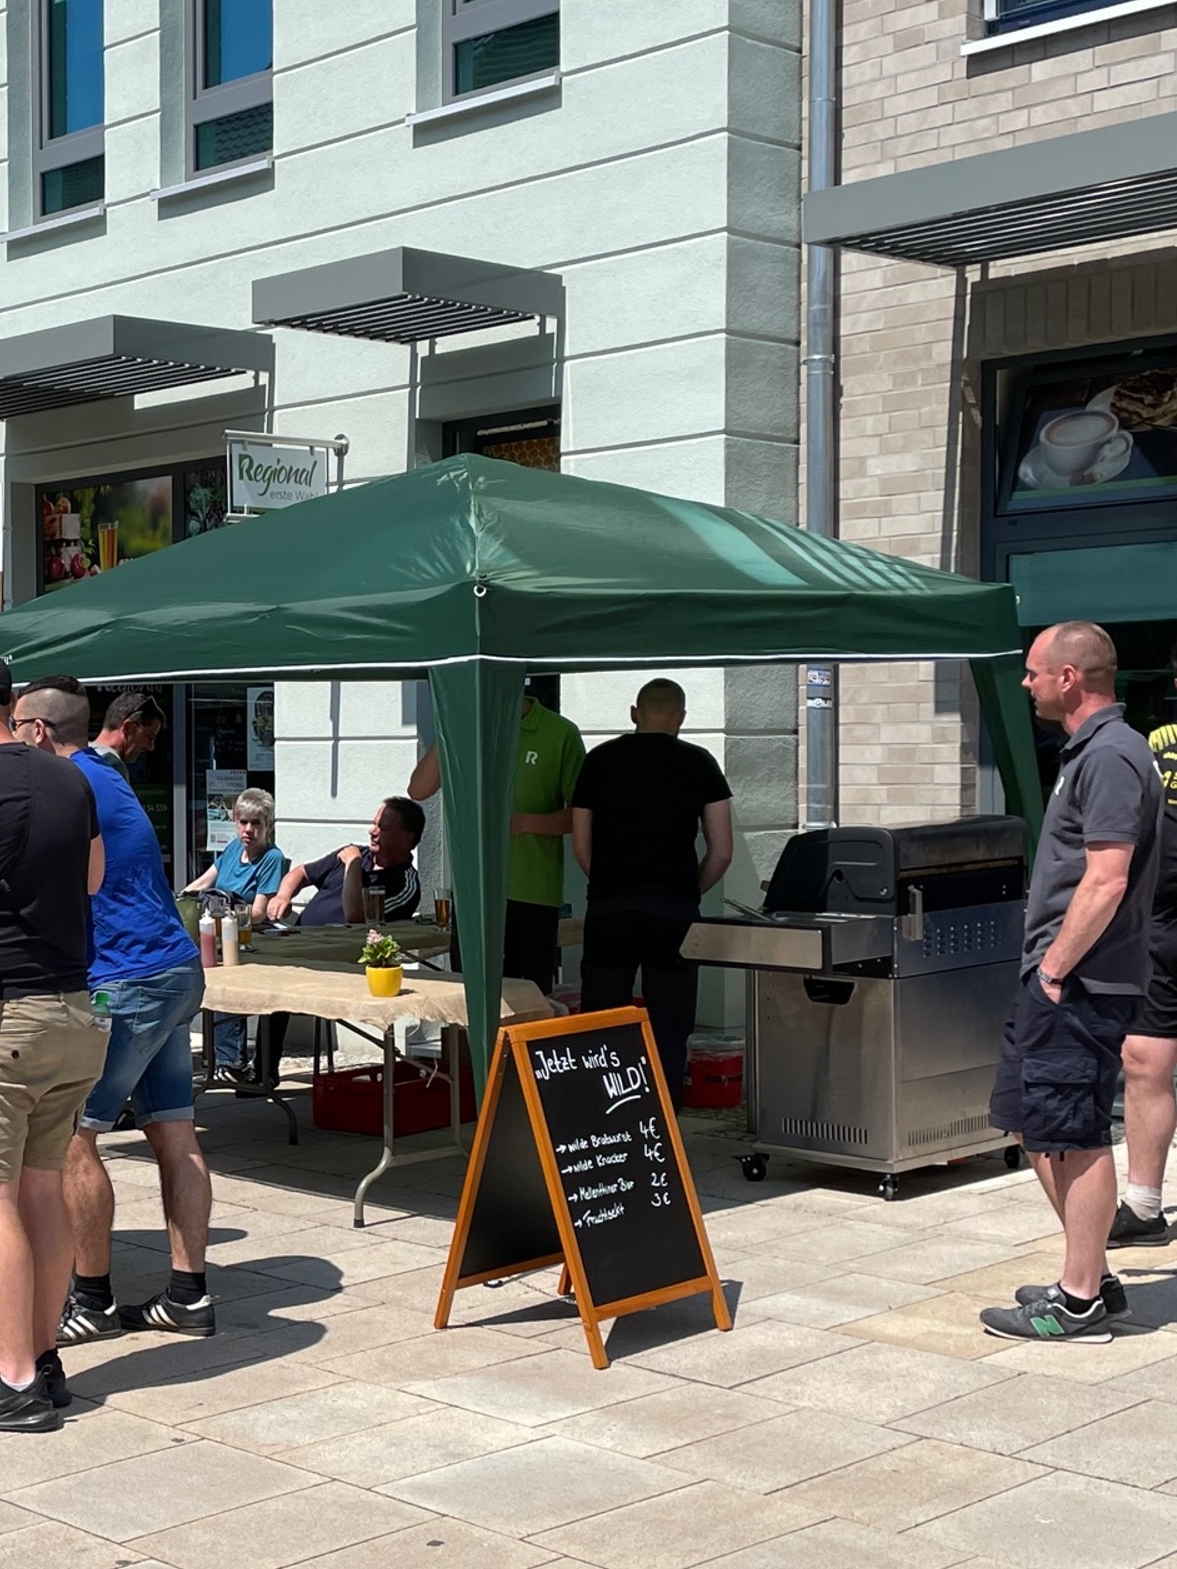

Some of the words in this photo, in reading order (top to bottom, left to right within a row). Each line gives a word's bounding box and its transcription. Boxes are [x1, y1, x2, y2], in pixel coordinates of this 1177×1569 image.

[238, 453, 317, 497] Regional
[269, 490, 293, 501] erste
[525, 751, 538, 765] R
[582, 1044, 621, 1068] wird's
[568, 1138, 589, 1153] wilde
[590, 1131, 633, 1148] Bratwurst
[639, 1117, 661, 1139] 4€
[573, 1160, 594, 1173] wilde
[596, 1153, 628, 1167] Knacker
[644, 1142, 665, 1163] 4€
[651, 1172, 668, 1187] 2€
[651, 1191, 671, 1207] 3€
